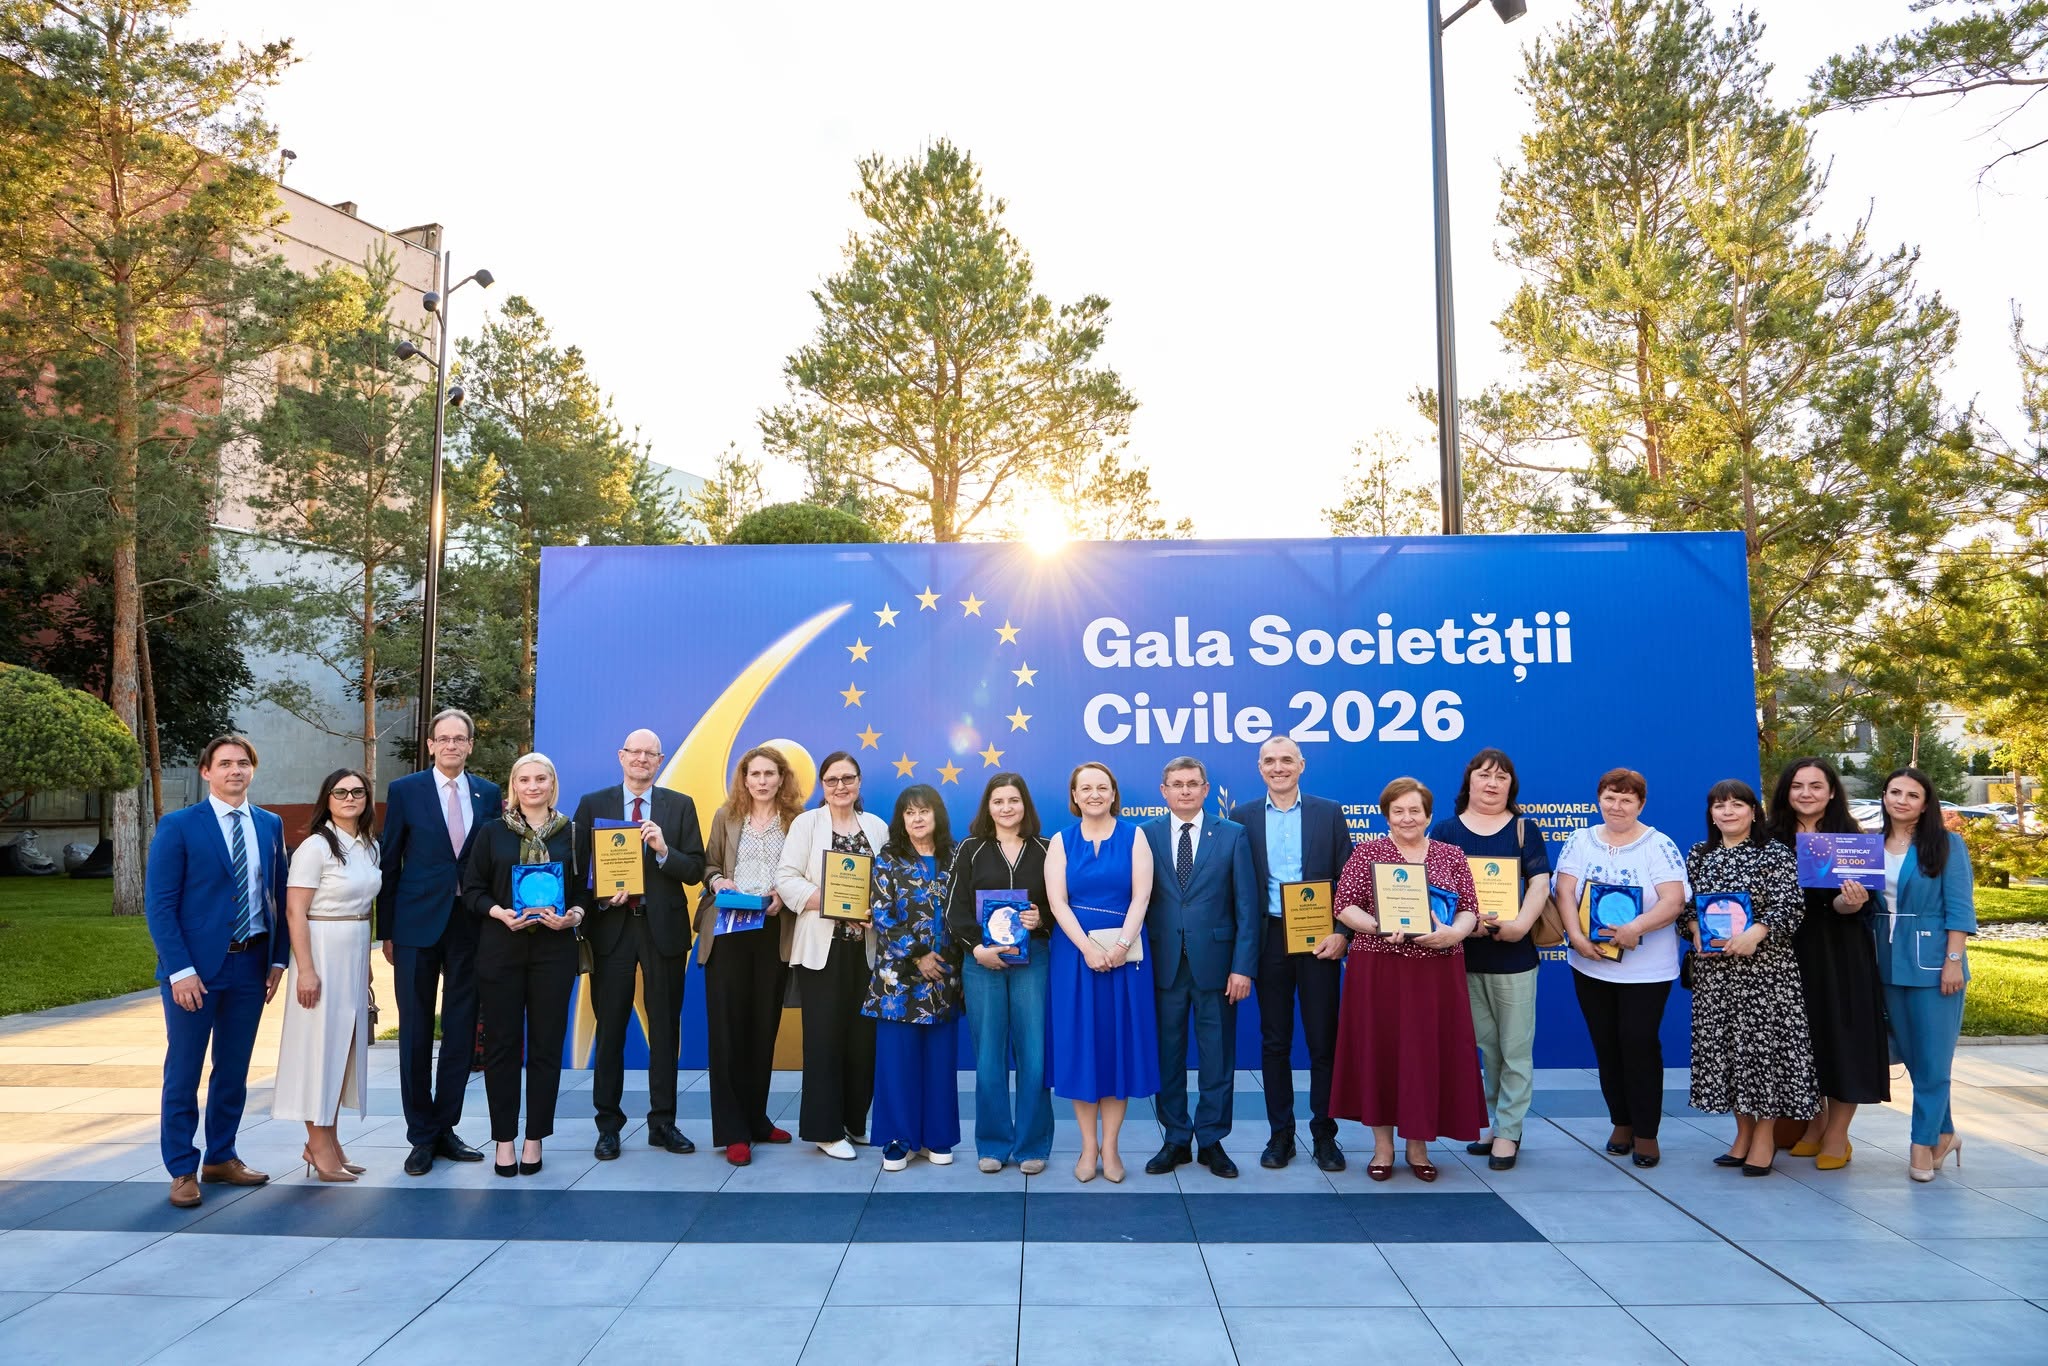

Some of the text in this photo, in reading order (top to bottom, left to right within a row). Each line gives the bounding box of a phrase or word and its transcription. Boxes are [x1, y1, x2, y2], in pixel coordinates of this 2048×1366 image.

[1082, 611, 1572, 683] Gala Societății
[1083, 689, 1465, 745] Civile 2026
[1121, 806, 1170, 817] GUVERN
[1341, 804, 1382, 815] CIETAT
[1518, 803, 1598, 814] ROMOVAREA
[1345, 818, 1370, 829] MAI
[1541, 831, 1569, 842] E GE
